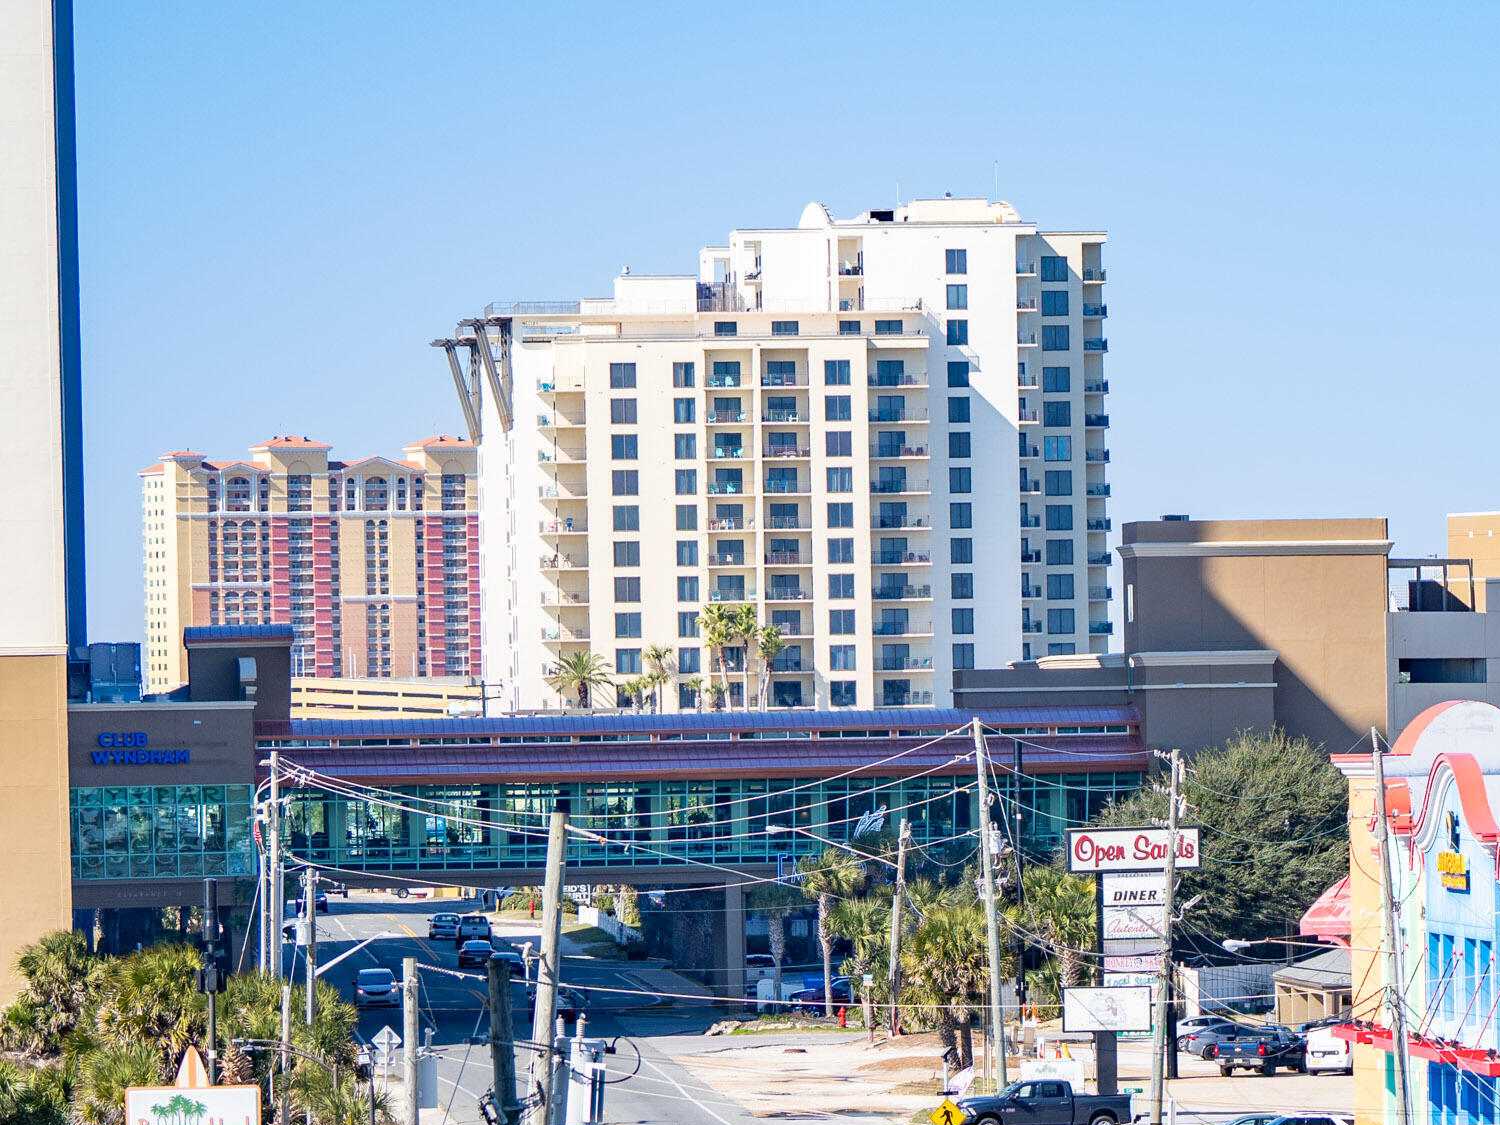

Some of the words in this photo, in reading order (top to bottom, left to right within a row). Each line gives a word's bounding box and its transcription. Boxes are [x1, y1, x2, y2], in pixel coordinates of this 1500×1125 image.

[99, 732, 148, 748] CLUB
[91, 750, 190, 765] WYNDHAM
[1075, 835, 1125, 867] Open
[1113, 890, 1157, 901] DINER
